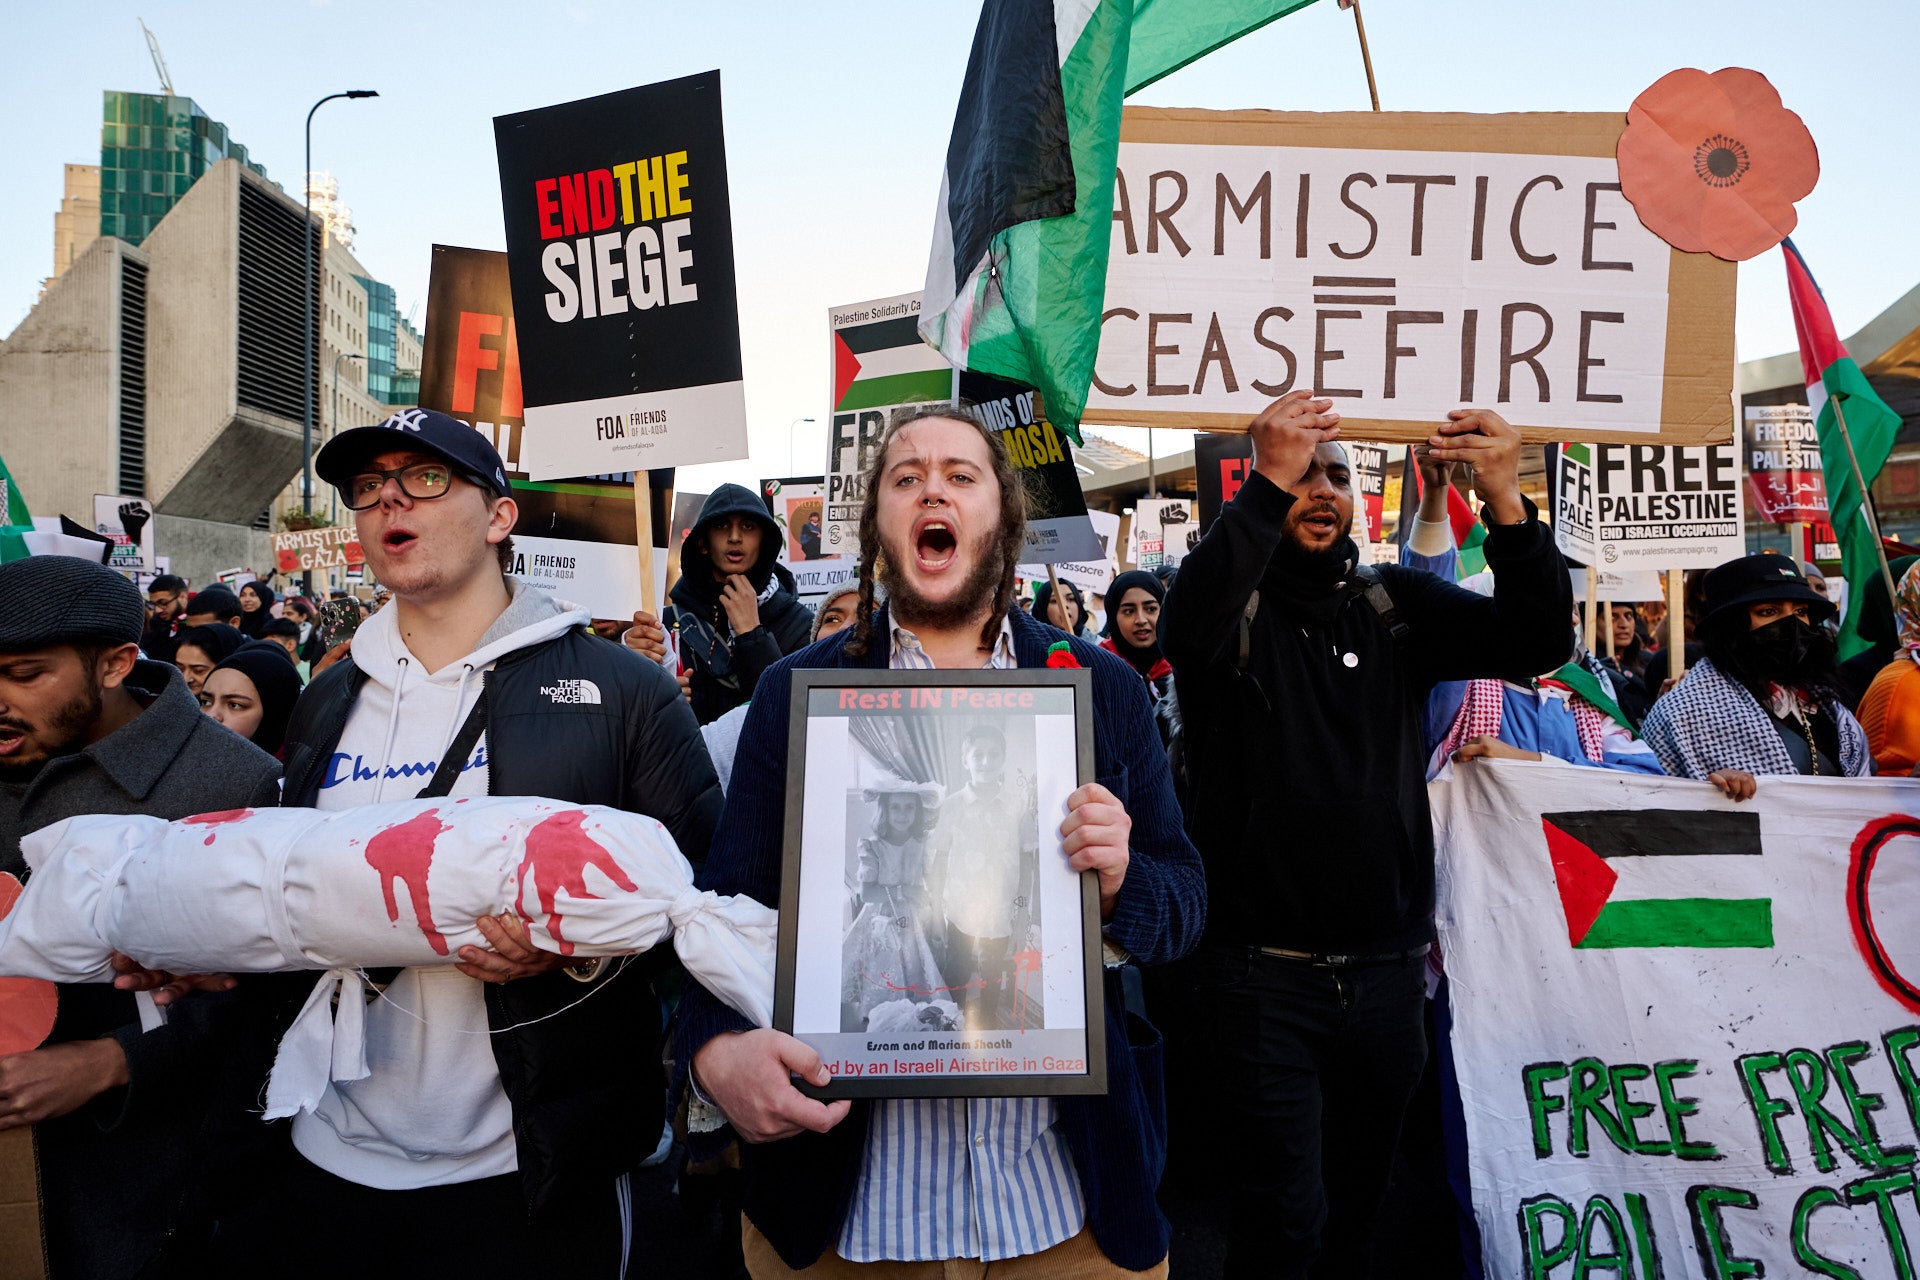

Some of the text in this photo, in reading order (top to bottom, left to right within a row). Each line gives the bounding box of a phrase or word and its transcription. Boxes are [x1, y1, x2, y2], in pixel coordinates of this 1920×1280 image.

[535, 150, 693, 240] END THE
[541, 217, 698, 323] SIEGE
[834, 309, 869, 325] Palestine
[871, 302, 908, 317] Solidarity
[1092, 301, 1625, 405] CEASEFIRE
[1759, 409, 1795, 418] Socialist
[597, 410, 667, 441] FOA FRIENDS
[641, 424, 668, 437] AL-AQSA
[1002, 421, 1065, 469] AQSA
[1597, 444, 1736, 493] FREE
[1768, 476, 1821, 496] الحرية
[1599, 493, 1737, 523] PALESTINE
[275, 528, 360, 551] ARMISTICE
[1601, 522, 1737, 540] END ISRAELI OCCUPATION
[300, 549, 348, 569] GAZA
[534, 554, 576, 569] FRIENDS
[1622, 545, 1718, 557] www.palestinecampaign.org
[544, 568, 575, 580] AL-AQSA
[541, 687, 580, 695] NORTH
[558, 680, 580, 688] THE
[552, 695, 580, 704] FACE
[838, 686, 1035, 709] Rest IN Peace
[866, 1038, 1012, 1052] Essam and Mariam Shaath
[844, 1060, 864, 1077] by
[868, 1062, 889, 1075] an
[893, 1058, 944, 1074] Israeli
[948, 1055, 1018, 1074] Airstrike
[1023, 1056, 1037, 1072] in
[1042, 1056, 1084, 1072] Gaza
[1521, 1056, 1727, 1161] FREE
